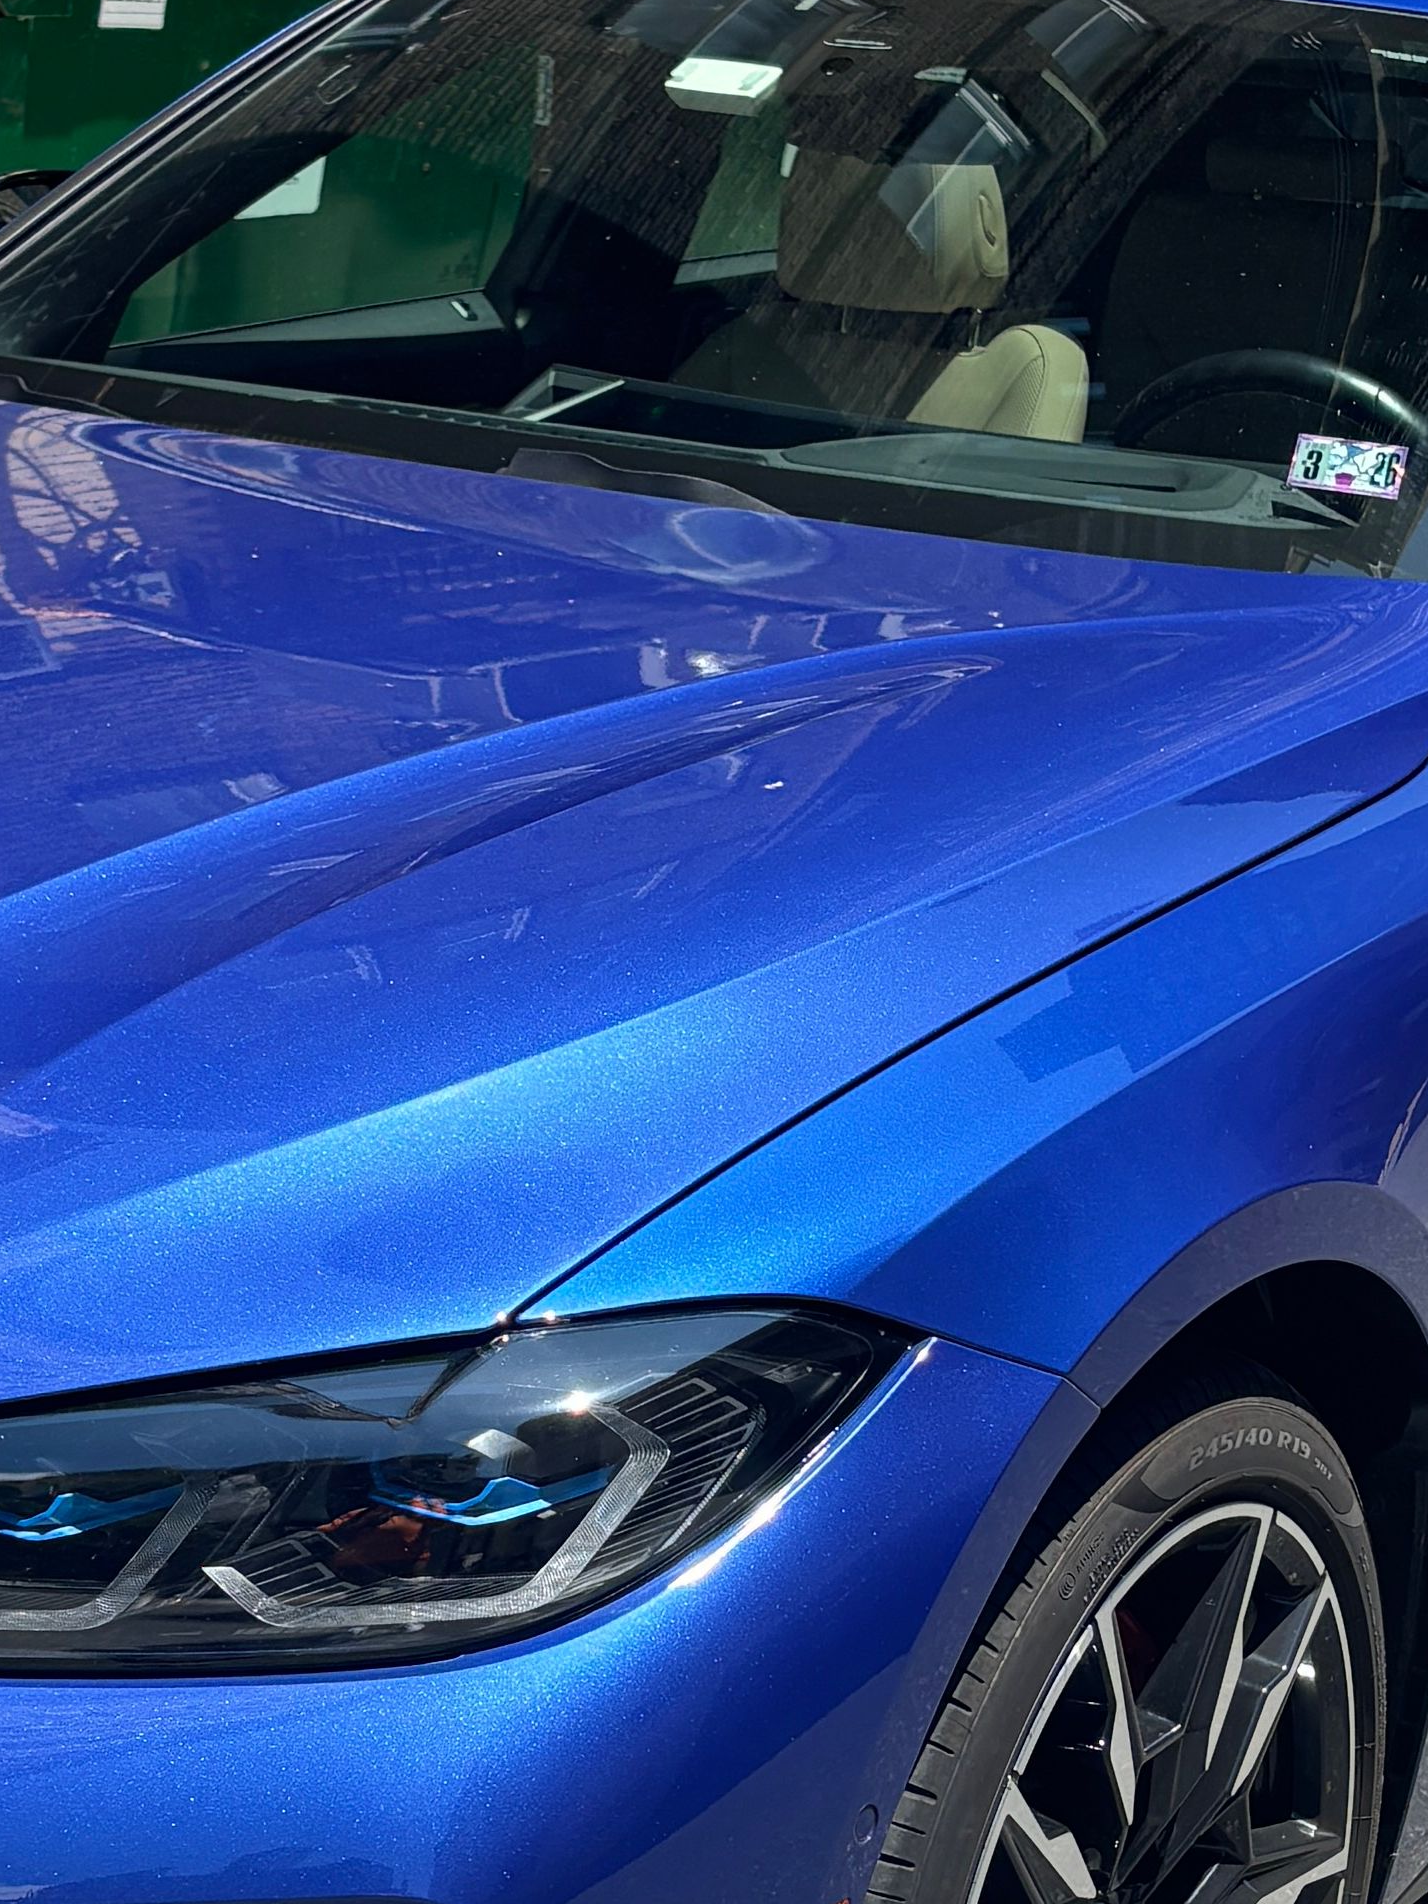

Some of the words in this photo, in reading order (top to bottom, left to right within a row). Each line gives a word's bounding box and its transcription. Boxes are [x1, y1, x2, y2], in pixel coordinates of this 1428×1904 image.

[1302, 449, 1323, 480] 3
[1369, 451, 1401, 487] 26
[1187, 1426, 1273, 1472] 245/40
[1275, 1430, 1312, 1460] R19
